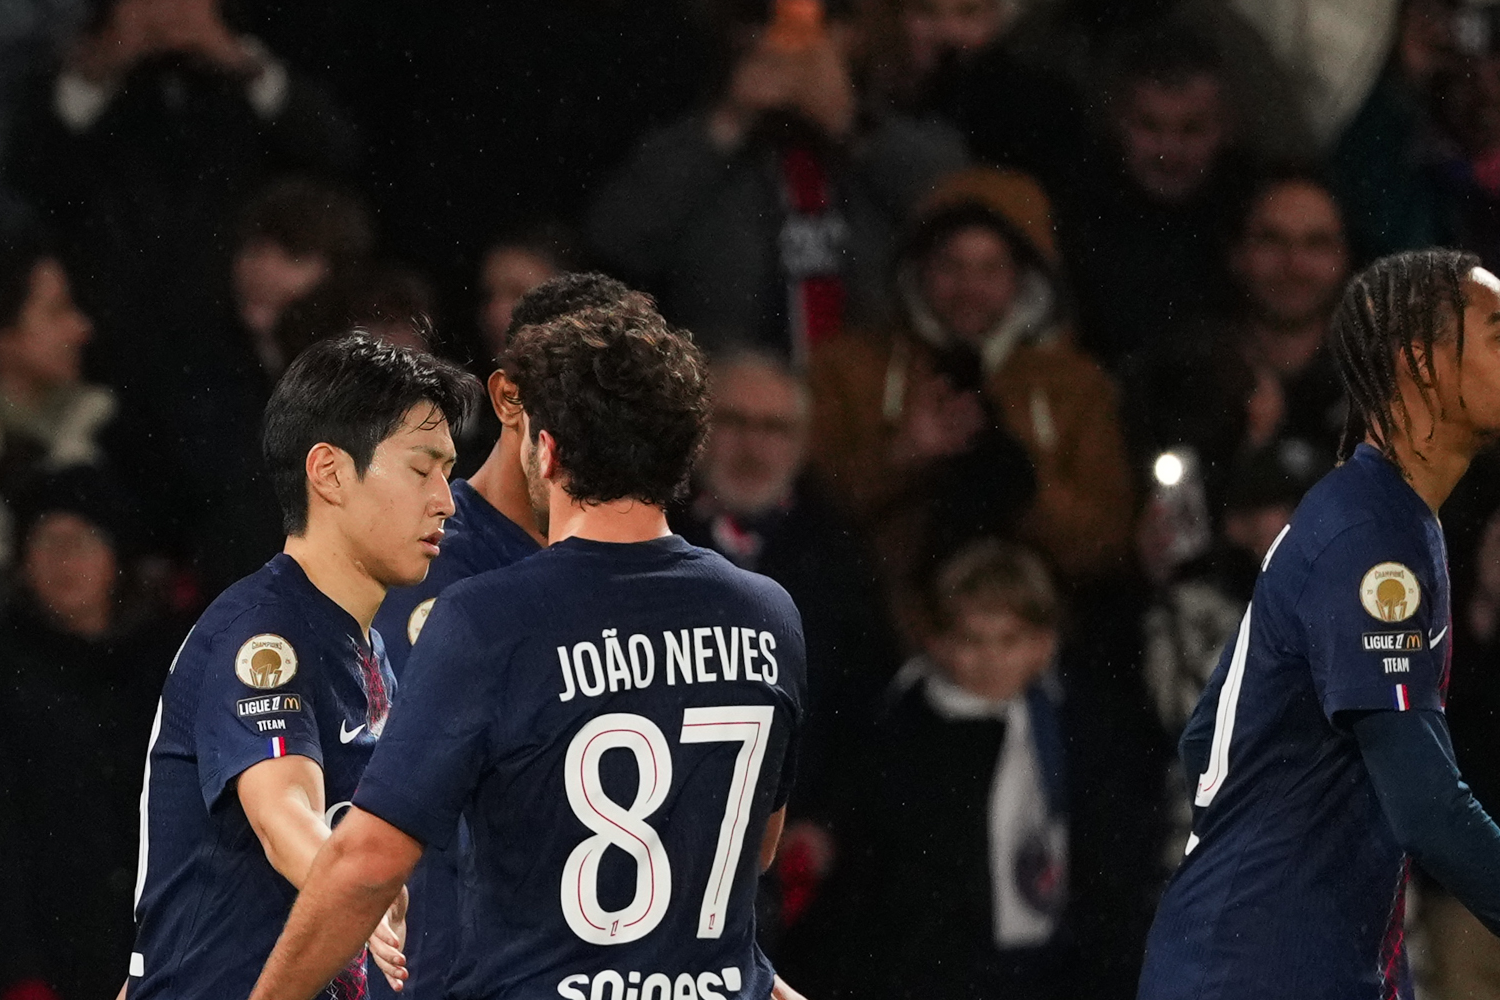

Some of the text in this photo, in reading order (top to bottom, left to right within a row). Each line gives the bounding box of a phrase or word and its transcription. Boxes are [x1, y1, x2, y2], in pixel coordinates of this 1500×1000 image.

[556, 626, 779, 702] JOÃO NEVES
[1364, 635, 1394, 650] LIGUE
[239, 698, 271, 716] LIGUE
[560, 705, 775, 945] 87
